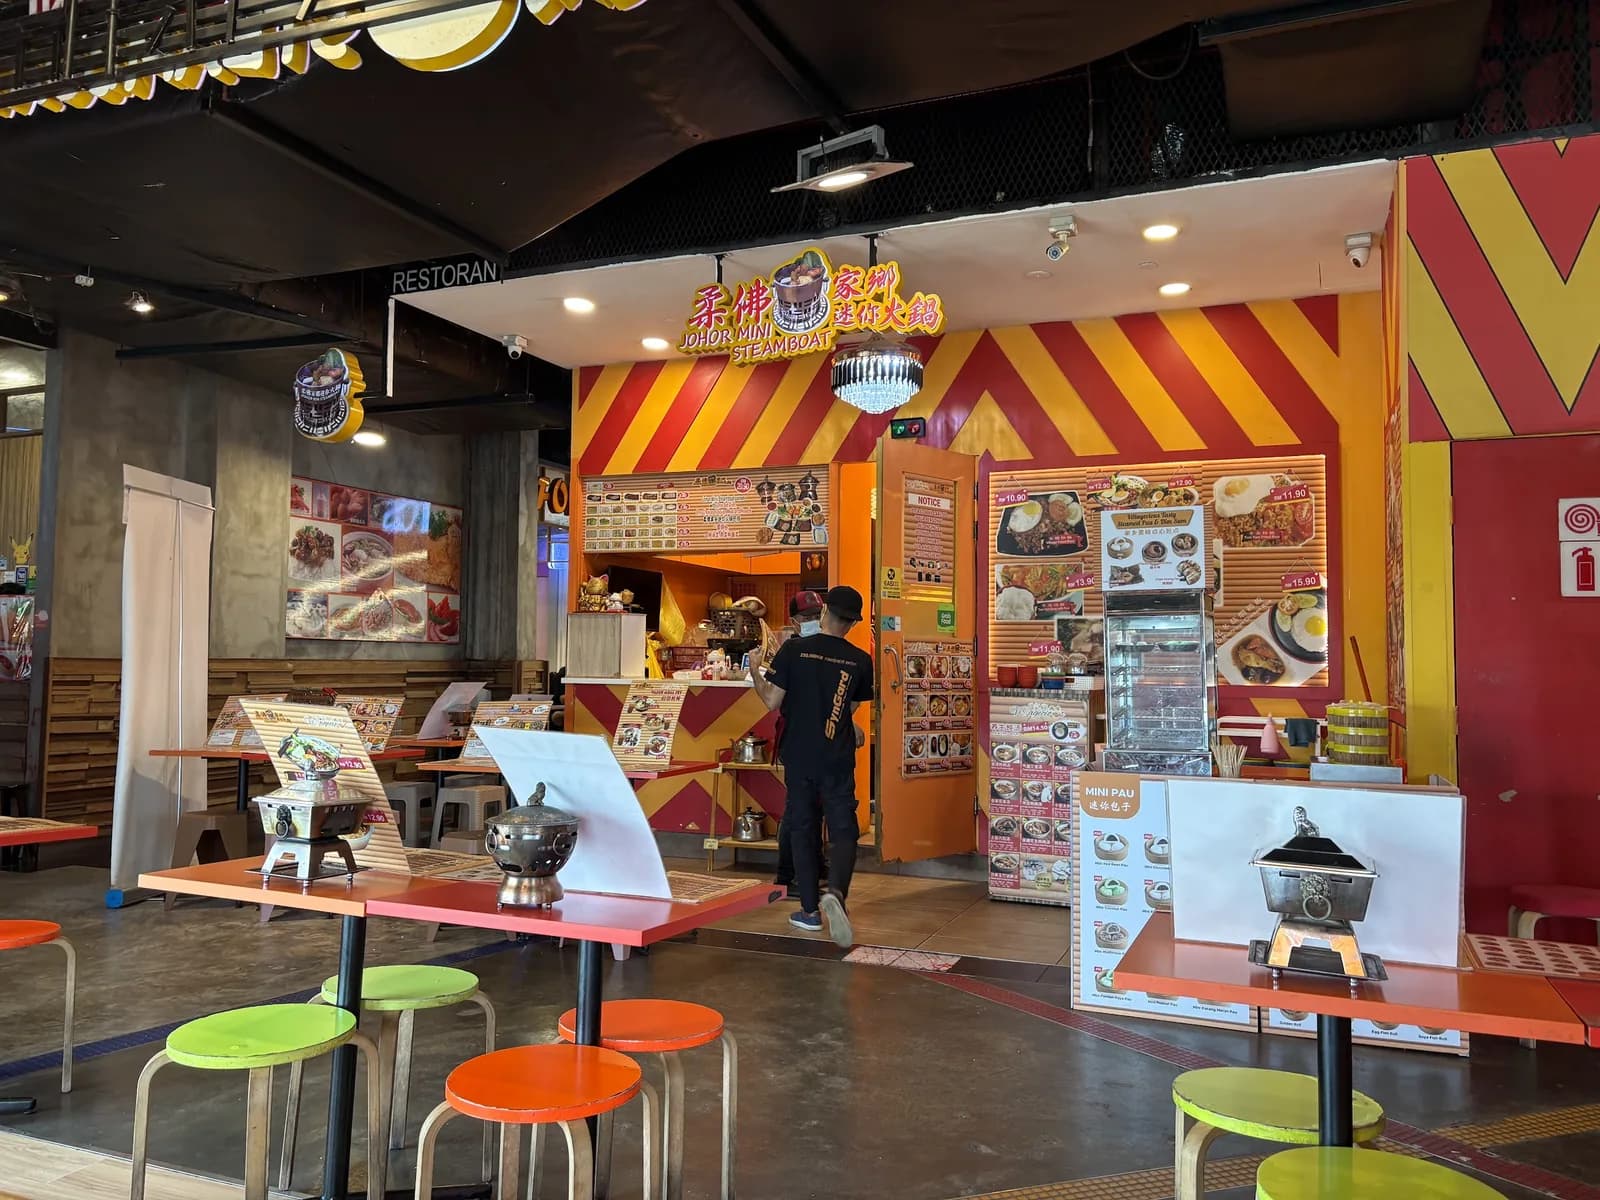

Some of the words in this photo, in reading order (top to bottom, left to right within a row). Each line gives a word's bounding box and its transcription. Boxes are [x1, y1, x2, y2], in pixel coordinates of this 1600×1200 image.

[393, 260, 496, 294] RESTORAN
[689, 279, 773, 330] 柔佛
[680, 328, 733, 349] JOHOR
[737, 322, 772, 342] MINI
[733, 331, 832, 362] STEAMBOAT
[918, 496, 941, 508] NOTICE
[1085, 787, 1109, 797] MINI
[1111, 788, 1135, 798] PAU
[1089, 800, 1131, 812] 迷你包子
